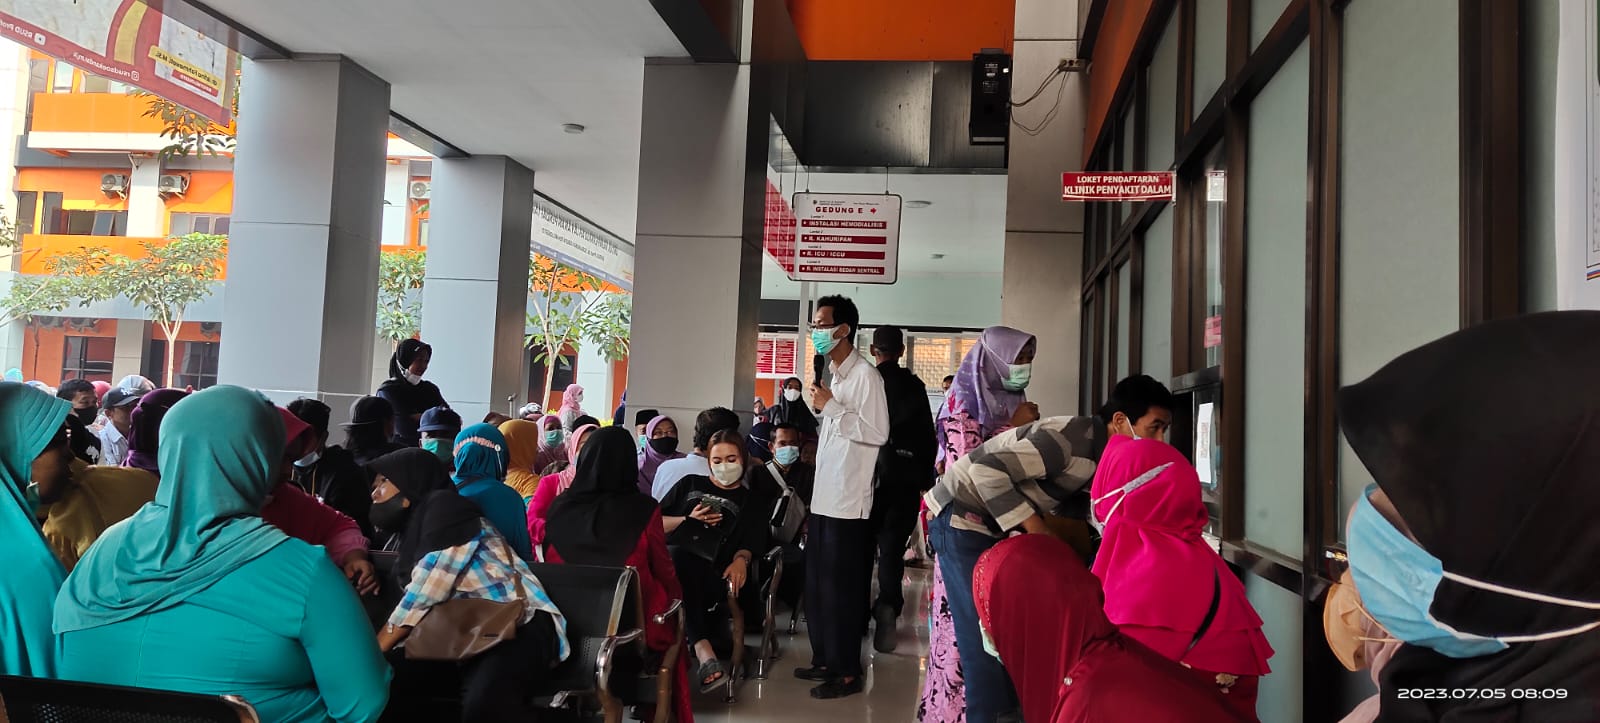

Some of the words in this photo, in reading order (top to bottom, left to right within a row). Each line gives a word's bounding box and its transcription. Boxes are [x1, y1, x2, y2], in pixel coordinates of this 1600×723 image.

[1103, 175, 1159, 183] PENDAFTARAN
[1064, 185, 1095, 194] KLINIK
[1097, 185, 1140, 194] PENYAKIT
[1141, 185, 1171, 194] DALAM
[815, 206, 854, 214] GEDUNG
